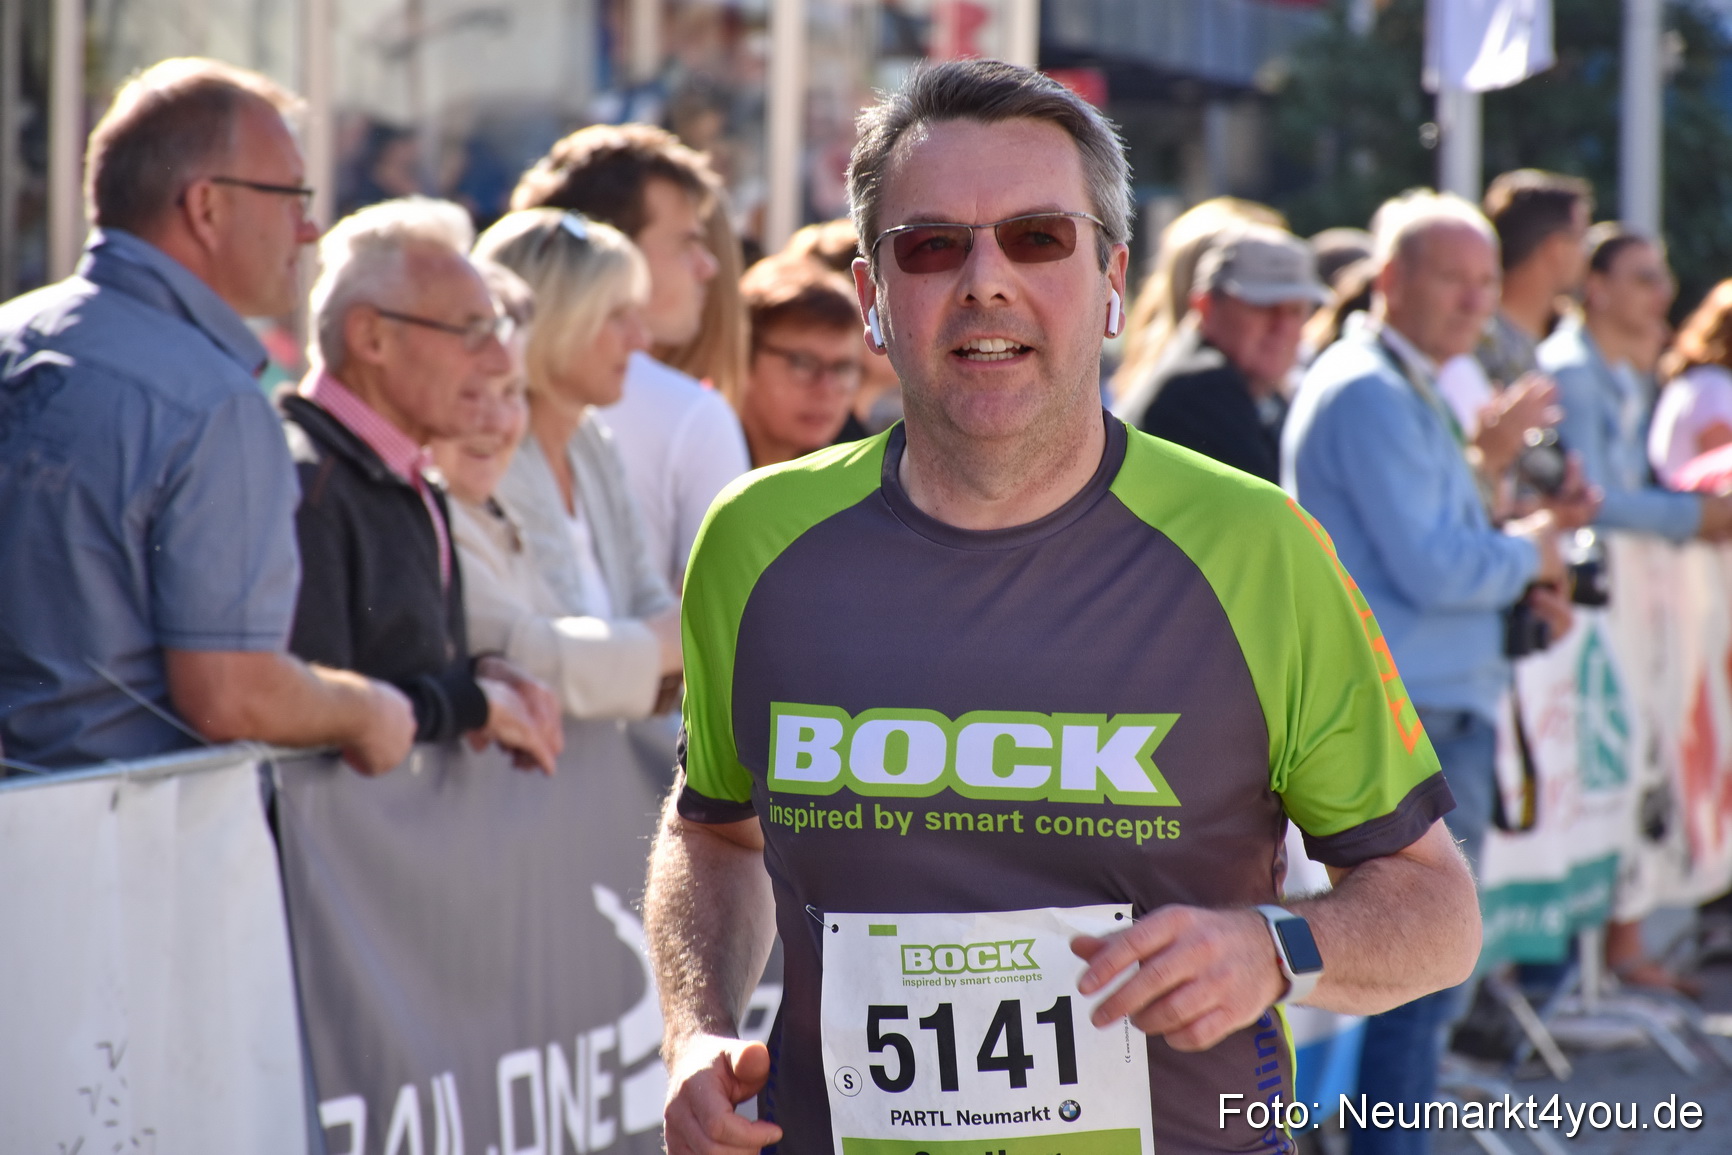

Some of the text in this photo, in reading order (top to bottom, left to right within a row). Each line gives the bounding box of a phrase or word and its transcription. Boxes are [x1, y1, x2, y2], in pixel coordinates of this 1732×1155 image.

[769, 705, 1175, 802] BOCK
[769, 798, 1181, 845] inspired by smart concepts
[902, 941, 1038, 974] BOCK
[902, 971, 1043, 989] inspired by smart concepts
[867, 996, 1078, 1094] 5141
[843, 1073, 854, 1090] S
[890, 1105, 1051, 1127] PARTL Neumarkt
